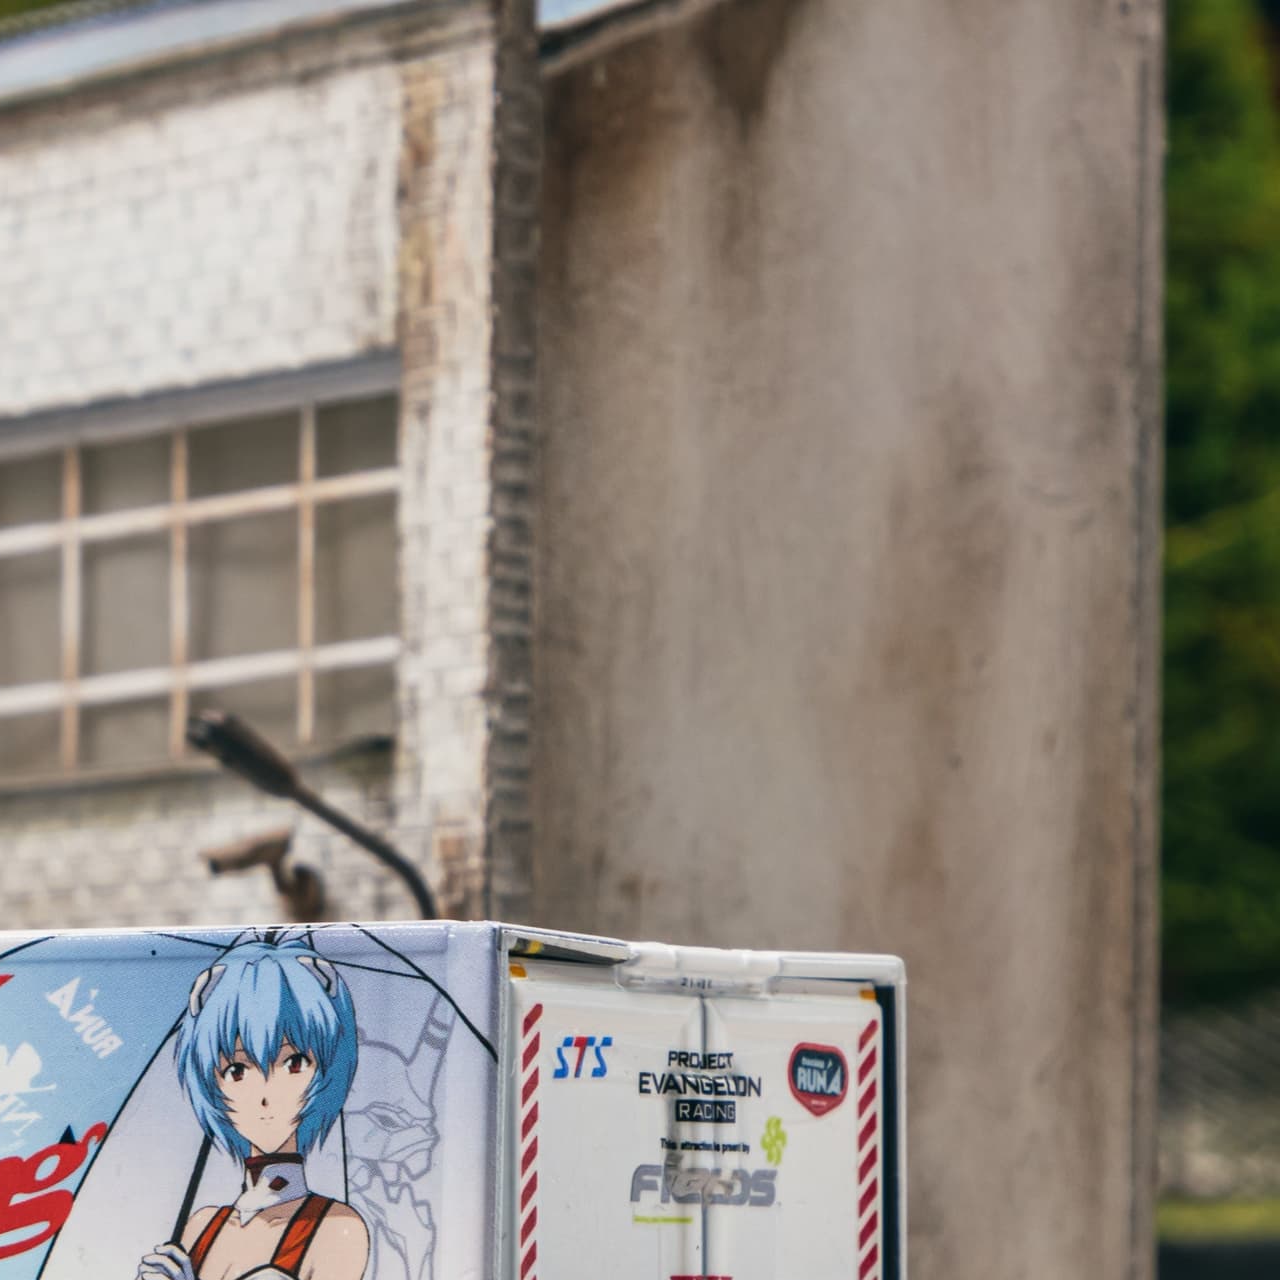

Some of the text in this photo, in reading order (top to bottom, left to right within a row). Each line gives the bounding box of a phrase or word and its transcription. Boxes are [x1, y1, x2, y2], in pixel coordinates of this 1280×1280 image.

[552, 1036, 613, 1079] STS
[668, 1050, 734, 1069] PROJECT
[679, 1103, 736, 1120] RACING
